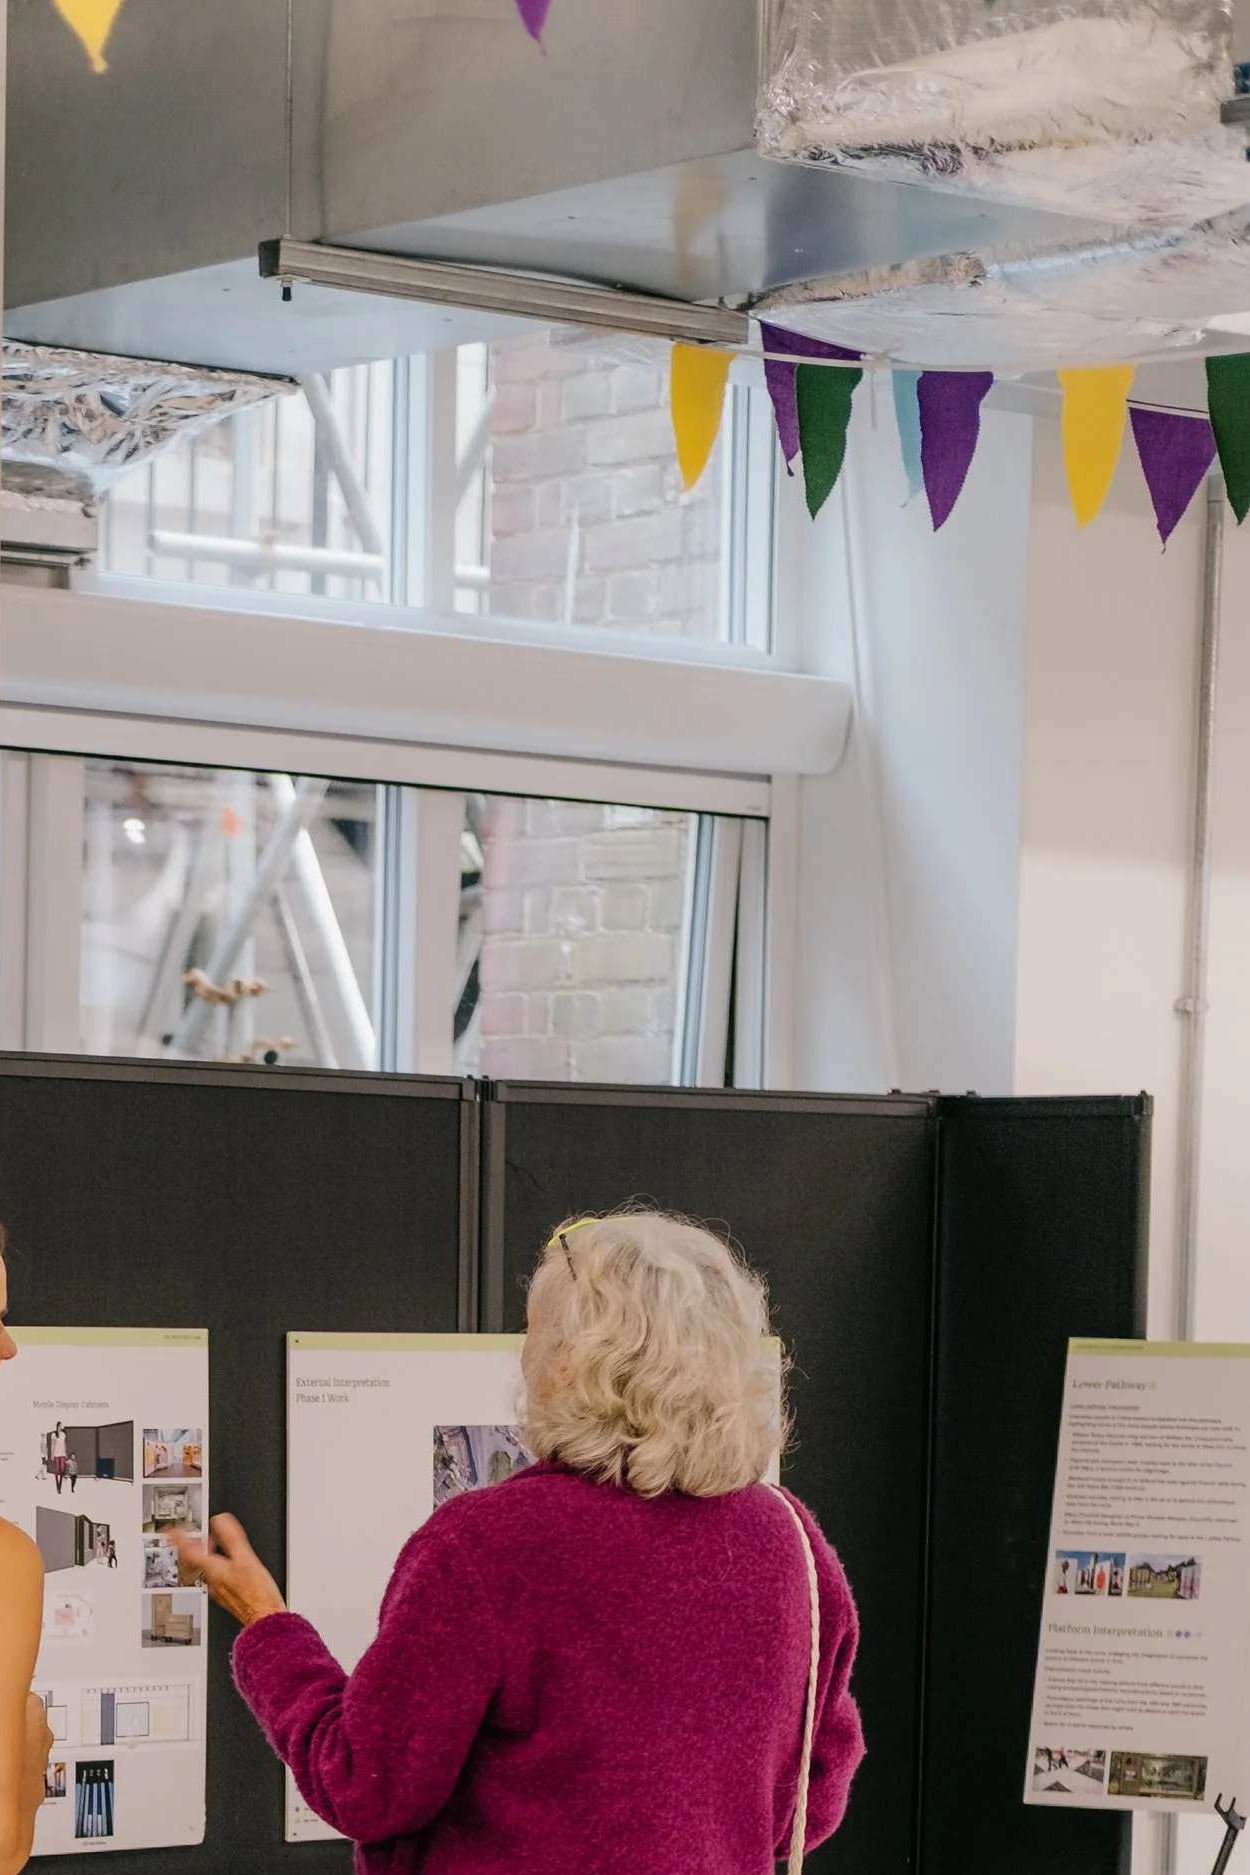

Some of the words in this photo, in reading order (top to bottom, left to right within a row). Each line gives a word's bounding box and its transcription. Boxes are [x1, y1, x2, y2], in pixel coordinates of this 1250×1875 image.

[296, 1377, 331, 1387] External
[333, 1377, 390, 1389] Interpretation
[1073, 1379, 1102, 1390] Lower
[1105, 1380, 1147, 1392] Pathway
[296, 1393, 320, 1403] Phase
[327, 1393, 349, 1403] Work
[32, 1400, 54, 1408] Mobile
[56, 1400, 79, 1410] Display
[81, 1400, 109, 1408] Cabinets
[1048, 1622, 1091, 1636] Platform
[1093, 1624, 1163, 1640] Interpretation
